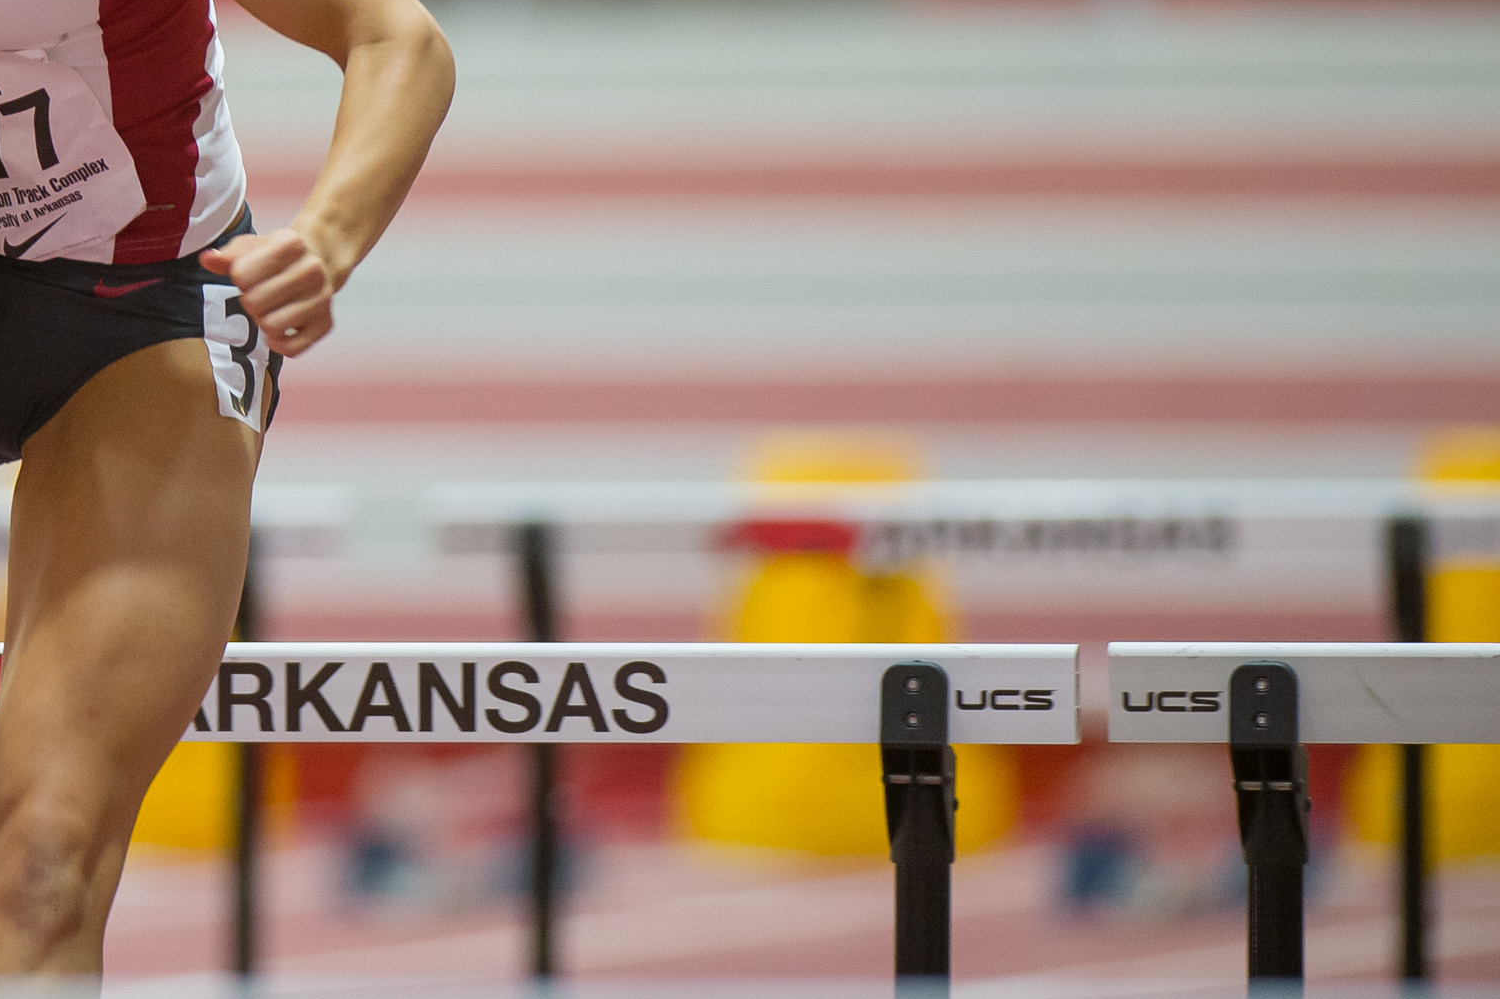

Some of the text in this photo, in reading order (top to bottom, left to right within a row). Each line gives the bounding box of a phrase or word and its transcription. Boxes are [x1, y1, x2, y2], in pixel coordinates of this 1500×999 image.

[11, 184, 51, 205] Track
[49, 157, 110, 193] Complex
[20, 209, 34, 223] of
[33, 190, 84, 219] Arkansas
[224, 295, 259, 417] 3
[193, 660, 670, 734] RKANSAS
[955, 689, 1057, 710] UCS
[1122, 691, 1222, 712] UCS
